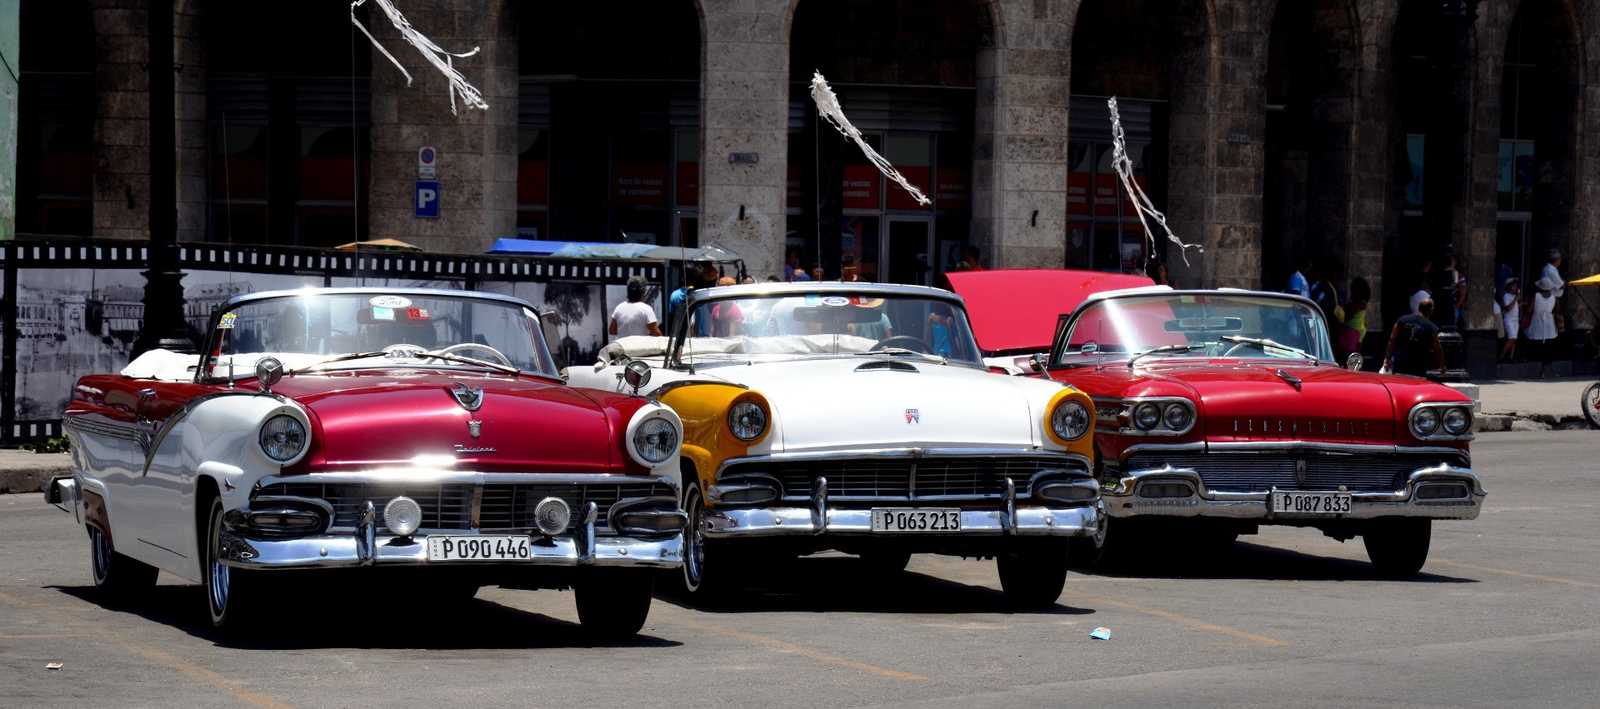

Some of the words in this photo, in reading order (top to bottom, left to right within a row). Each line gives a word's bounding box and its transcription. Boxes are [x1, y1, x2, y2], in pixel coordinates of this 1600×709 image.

[419, 188, 436, 208] P
[1284, 495, 1292, 511] P
[1295, 495, 1321, 512] 087
[1324, 496, 1350, 512] 833
[884, 512, 894, 530] P
[897, 512, 927, 530] 063
[930, 512, 959, 530] 213
[442, 540, 453, 558] P
[458, 539, 491, 559] 090
[495, 539, 528, 559] 446
